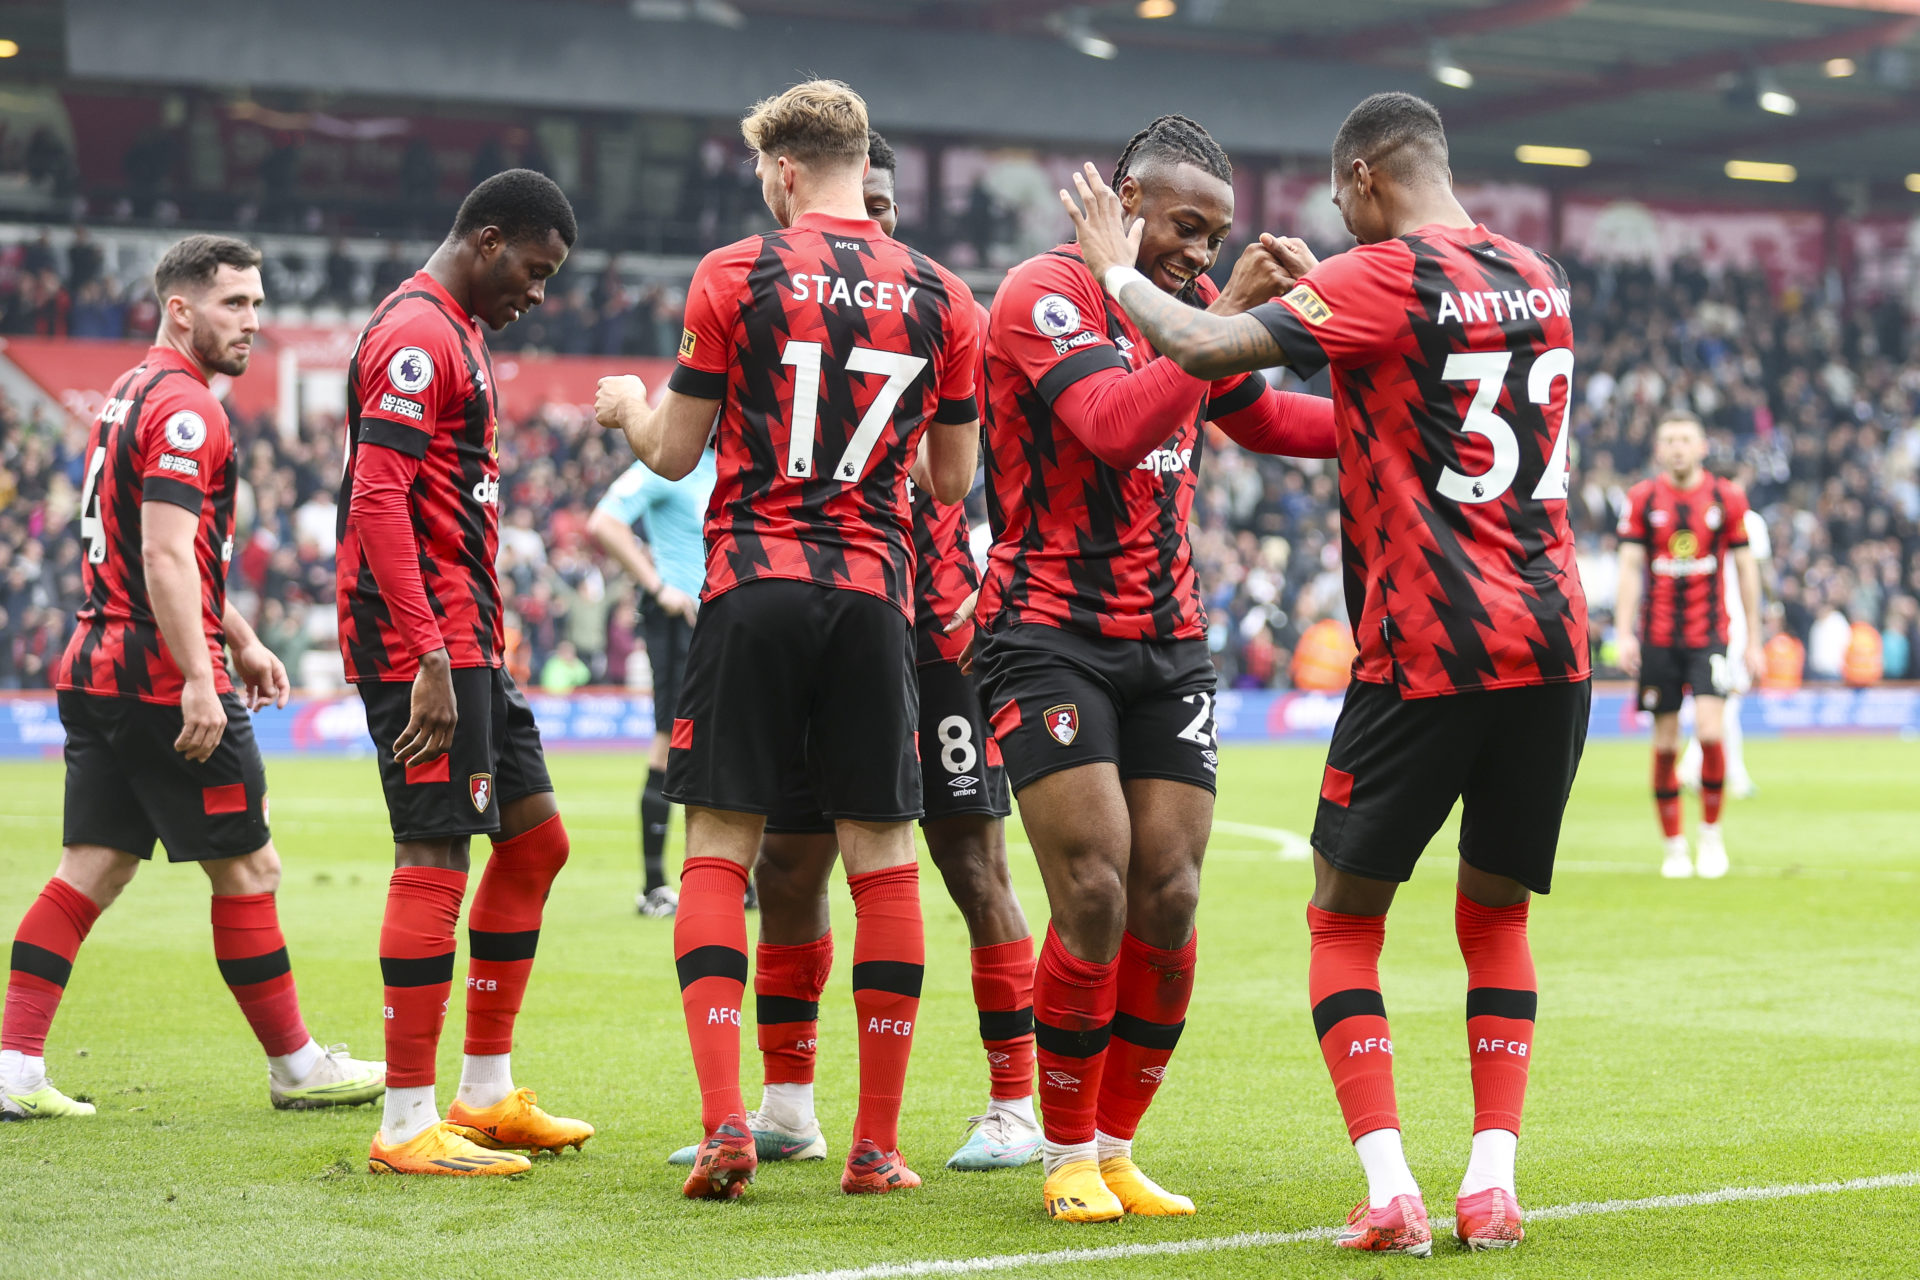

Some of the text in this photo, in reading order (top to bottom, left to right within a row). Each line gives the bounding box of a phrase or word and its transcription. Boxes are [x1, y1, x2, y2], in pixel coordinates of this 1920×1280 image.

[835, 241, 860, 251] AFCB
[792, 272, 919, 314] STACEY
[1291, 291, 1327, 320] ALT
[681, 333, 695, 352] LT
[379, 401, 423, 421] for racism
[382, 392, 422, 413] No room
[780, 340, 929, 483] 17
[1435, 347, 1575, 504] 32
[160, 453, 198, 469] No room
[81, 446, 107, 564] 4
[937, 714, 977, 774] 8
[952, 788, 977, 797] umbro
[868, 1016, 913, 1036] AFCB
[1476, 1037, 1528, 1057] AFCB
